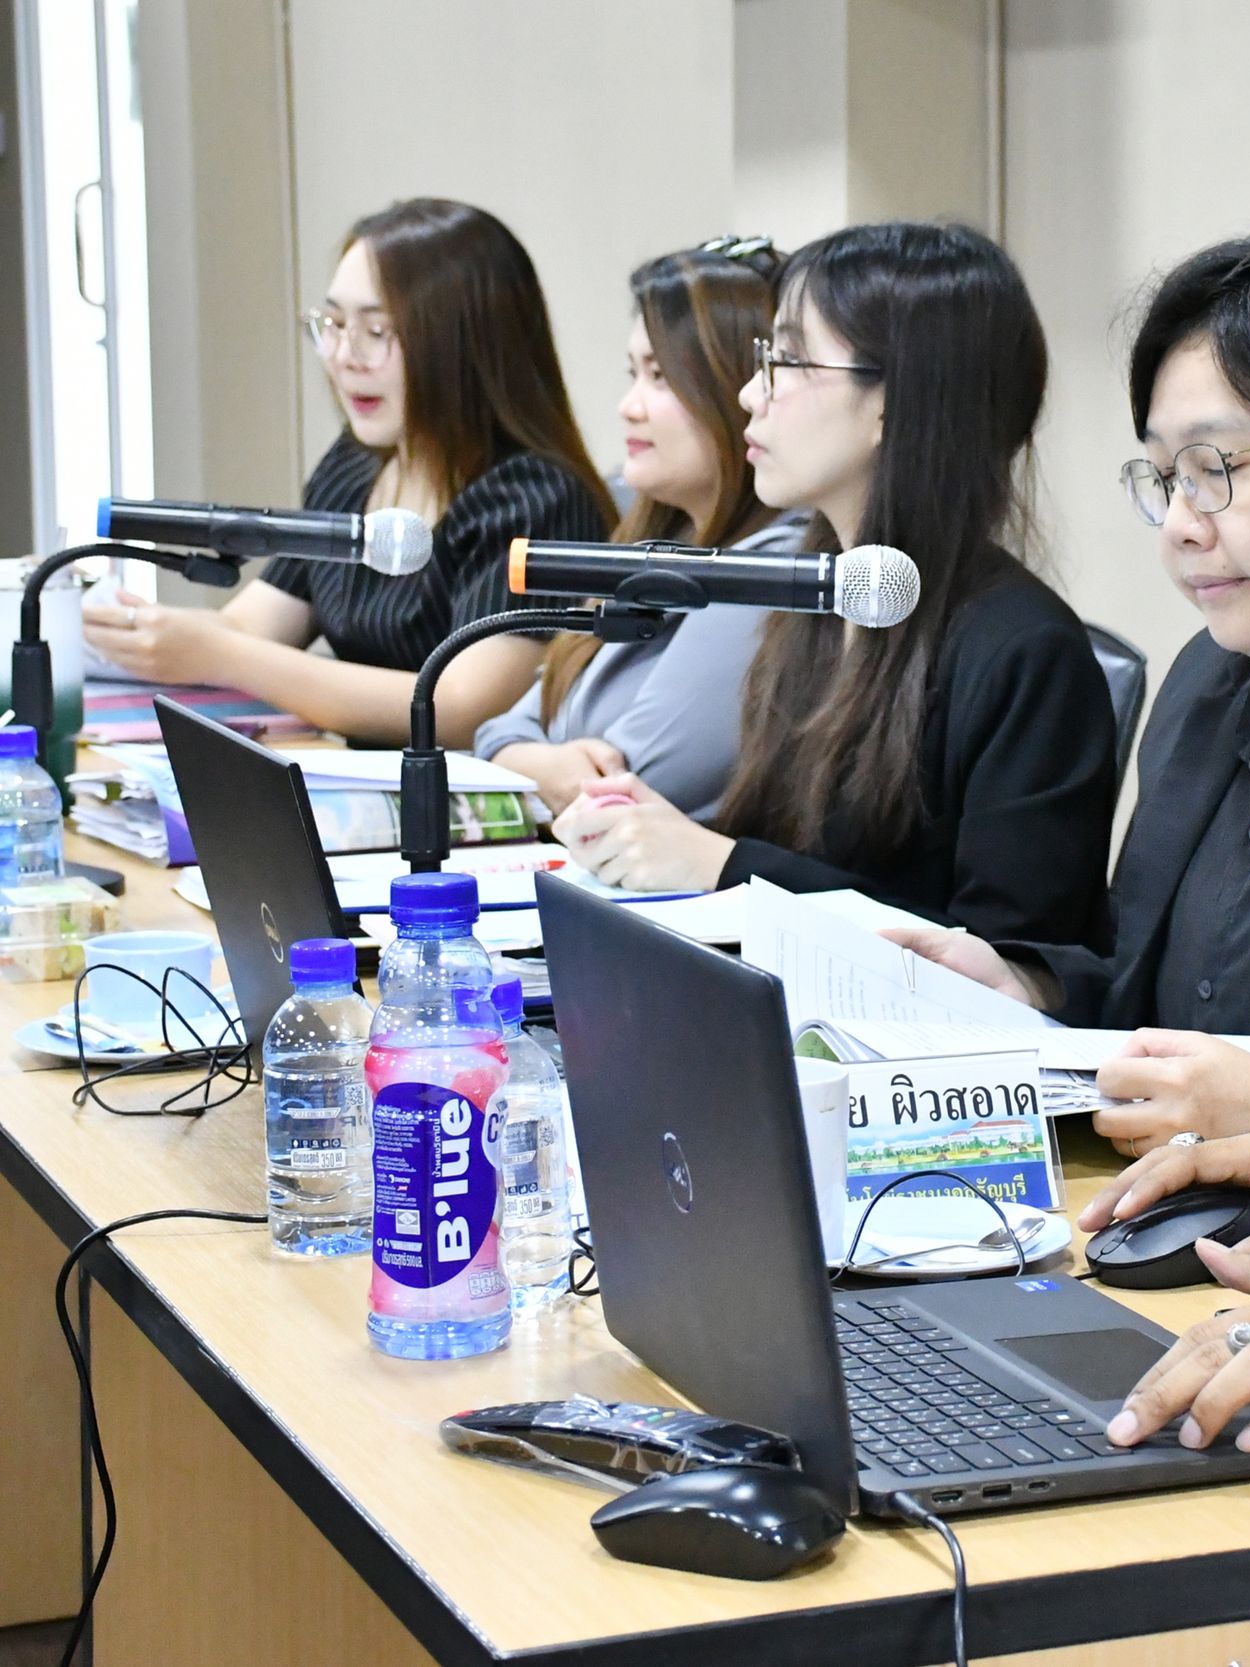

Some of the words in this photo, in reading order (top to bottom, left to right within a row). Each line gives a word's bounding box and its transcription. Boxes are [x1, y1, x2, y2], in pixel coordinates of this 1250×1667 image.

[890, 1073, 1040, 1125] ผิวสอาด
[321, 1153, 335, 1168] 350
[519, 1198, 533, 1215] 350
